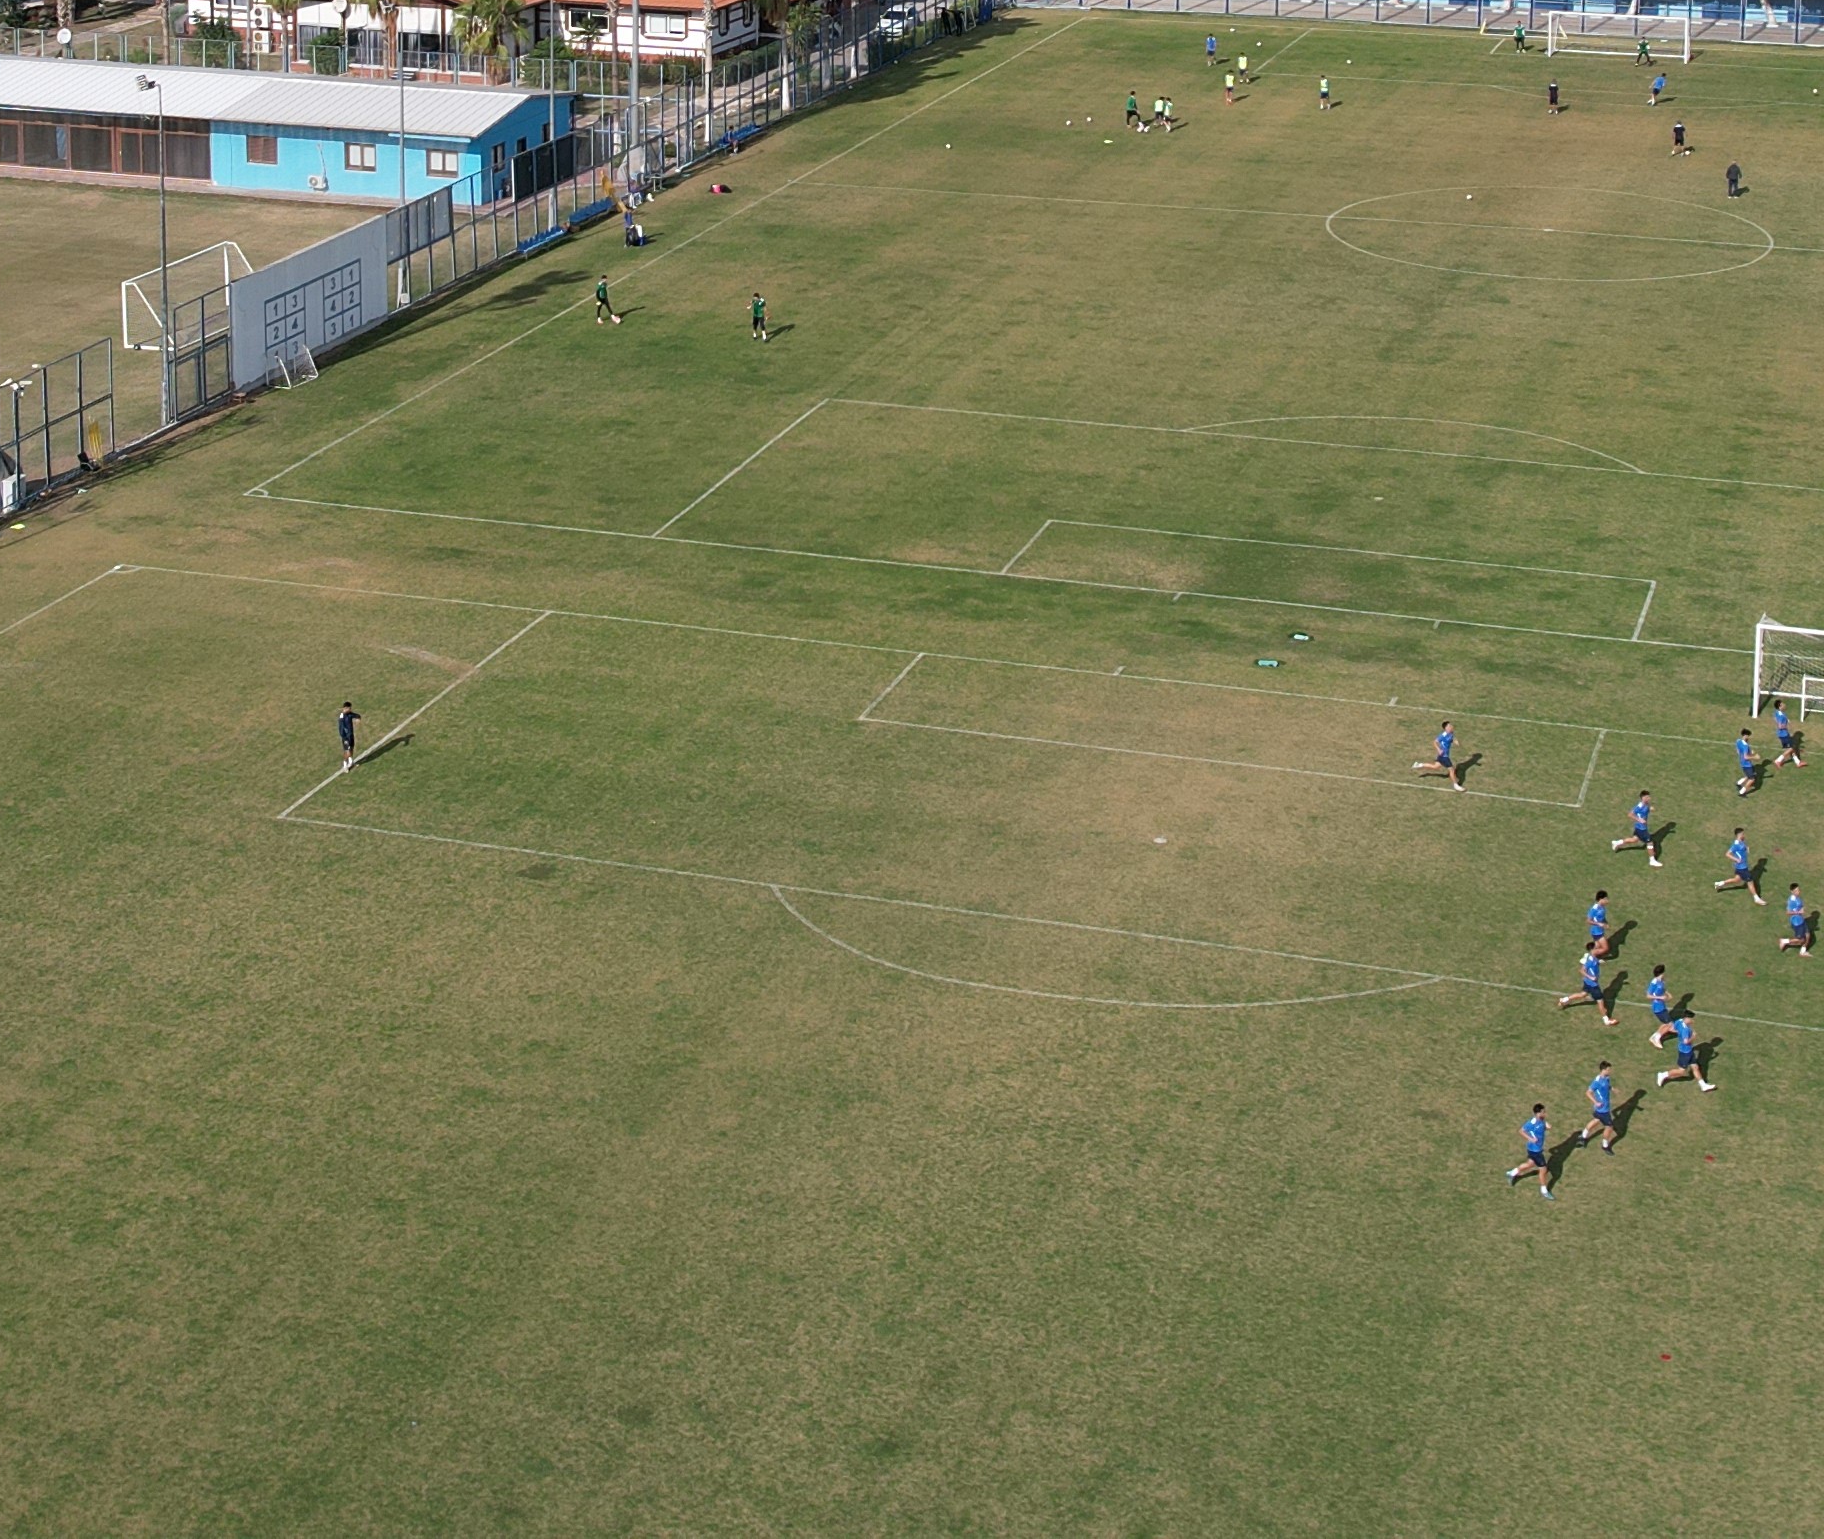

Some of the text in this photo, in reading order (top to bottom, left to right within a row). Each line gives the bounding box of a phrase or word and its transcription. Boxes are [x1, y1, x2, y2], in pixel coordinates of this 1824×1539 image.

[330, 269, 353, 290] 3 1
[274, 295, 298, 316] 1 3
[330, 291, 354, 312] 4 2
[274, 317, 298, 340] 2 4
[331, 314, 354, 335] 3 1
[292, 341, 298, 354] 3
